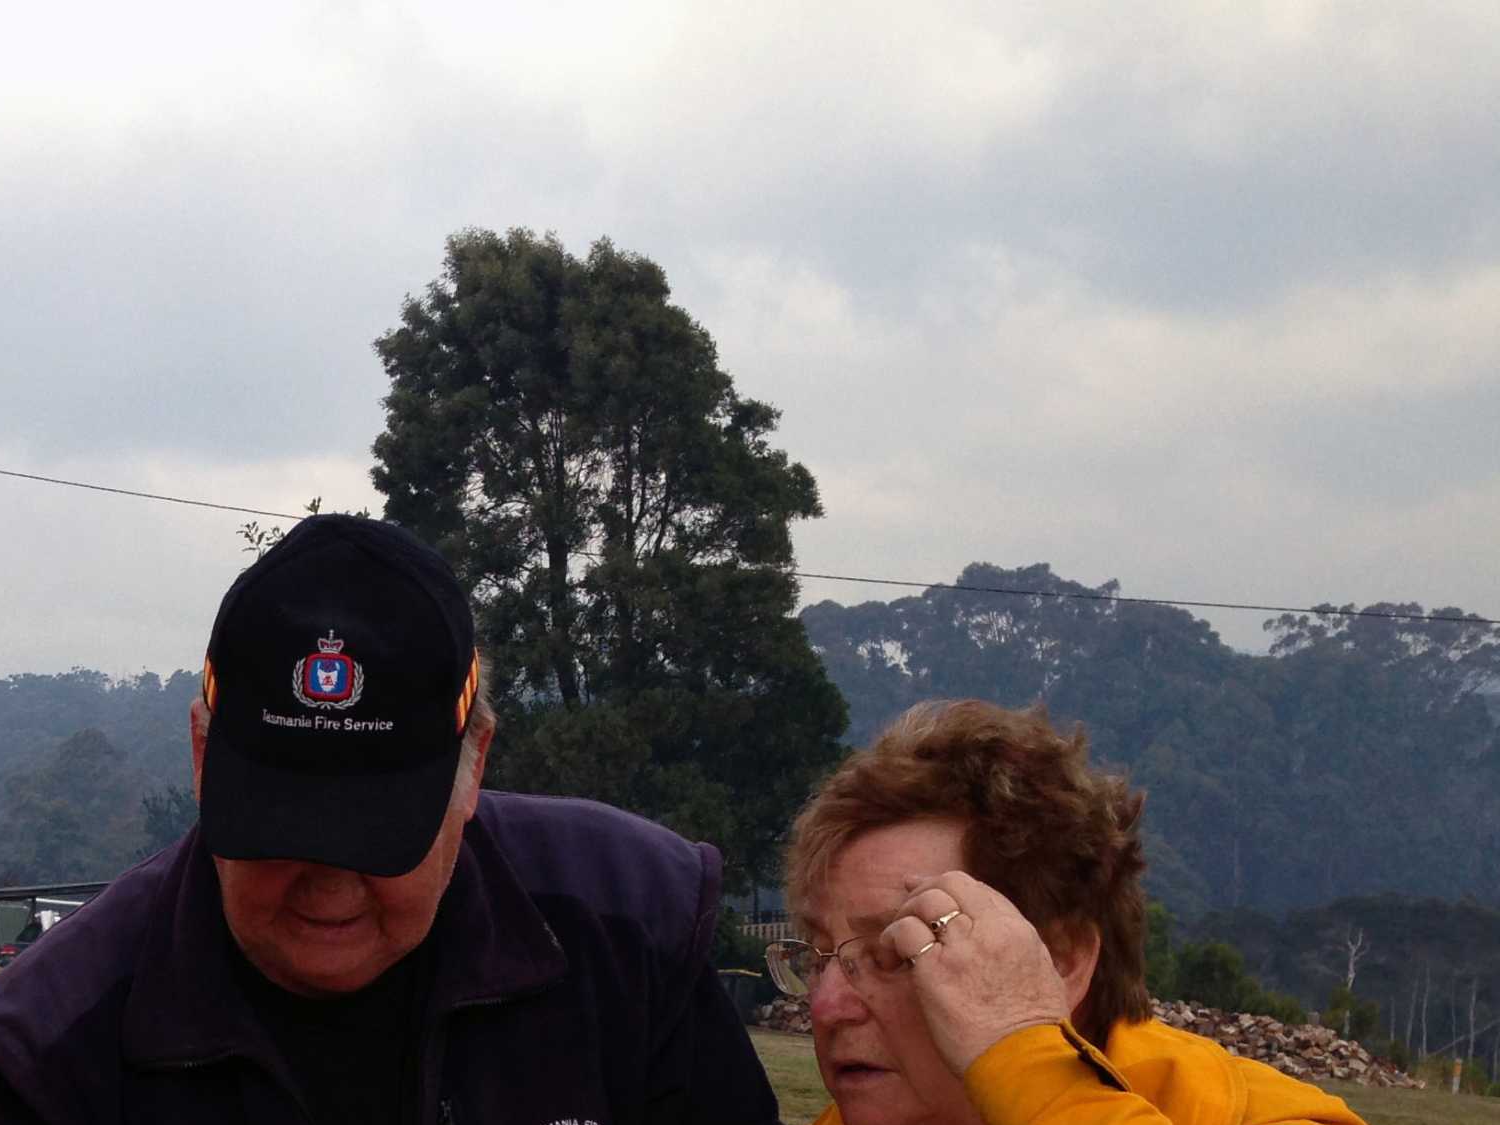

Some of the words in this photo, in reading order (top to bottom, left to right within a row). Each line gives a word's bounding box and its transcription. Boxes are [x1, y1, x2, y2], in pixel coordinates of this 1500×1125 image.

[262, 708, 312, 728] Tasmania
[315, 715, 341, 730] Fire
[344, 718, 394, 731] Service
